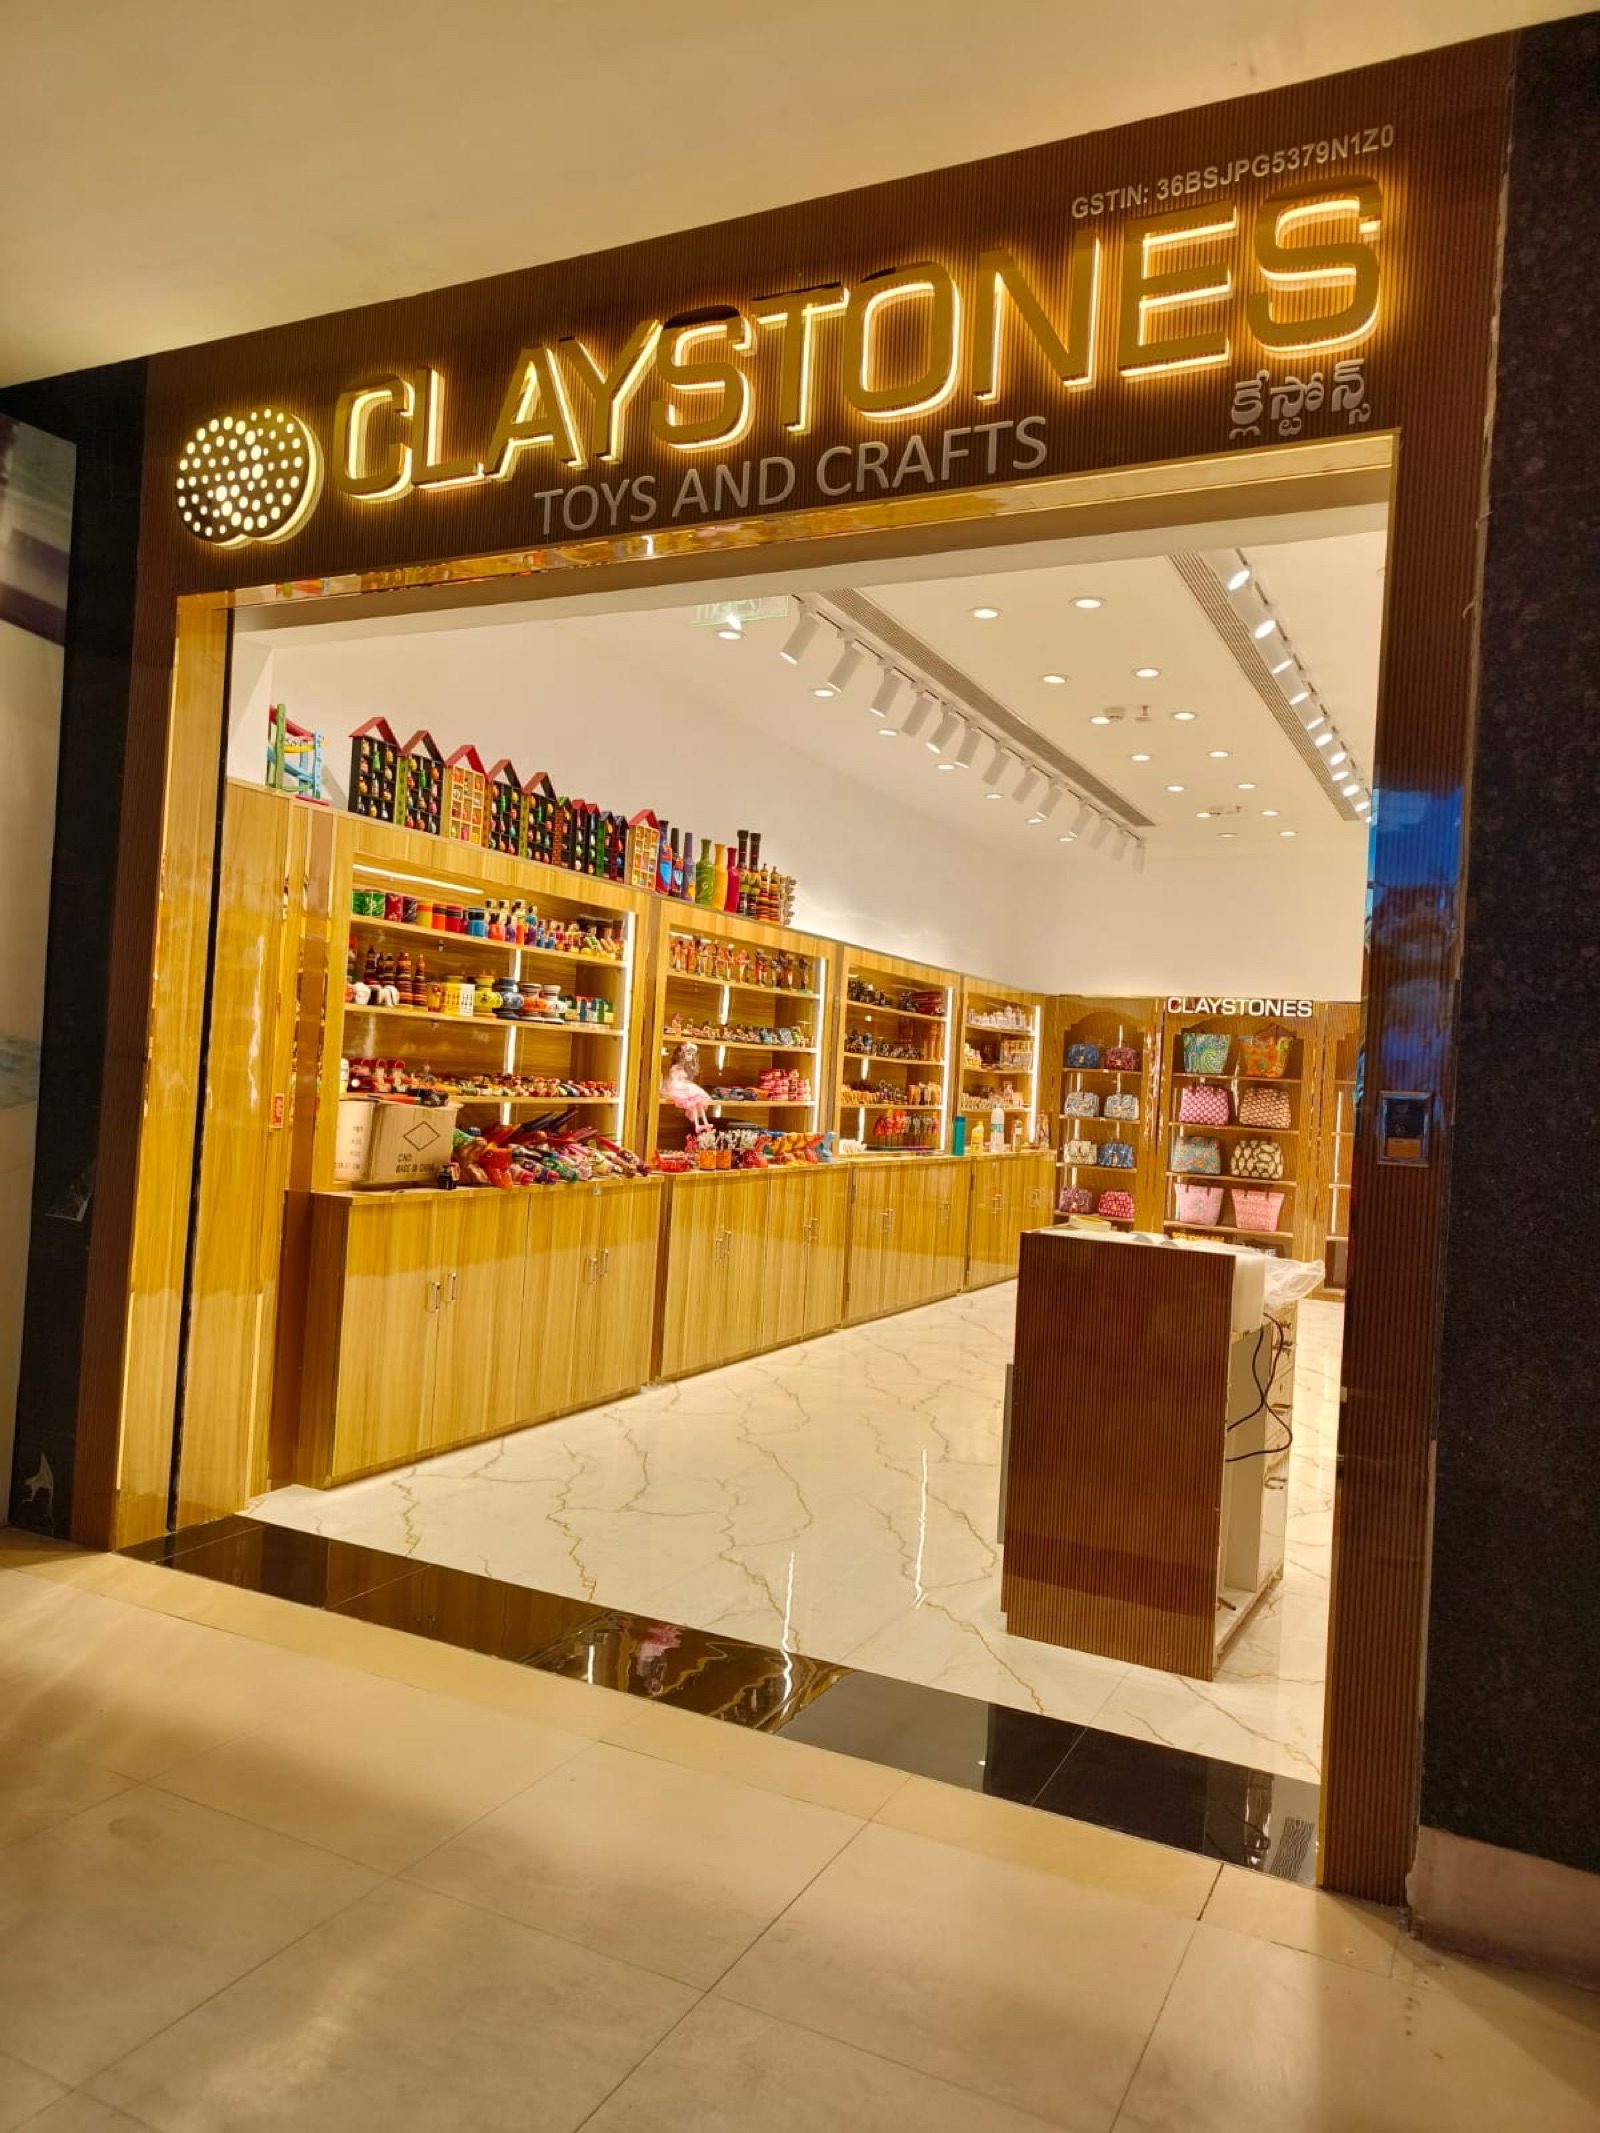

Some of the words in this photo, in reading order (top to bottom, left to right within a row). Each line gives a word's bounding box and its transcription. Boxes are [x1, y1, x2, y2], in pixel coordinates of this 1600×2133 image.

[1071, 185, 1150, 219] GSTIN:
[1155, 123, 1395, 202] 36BSJPG5379N1Z0
[333, 174, 1384, 503] CLAYSTONES
[534, 475, 657, 536] TOYS
[672, 456, 796, 518] AND
[816, 415, 1048, 497] CRAFTS
[1167, 996, 1313, 1018] CLAYSTONES
